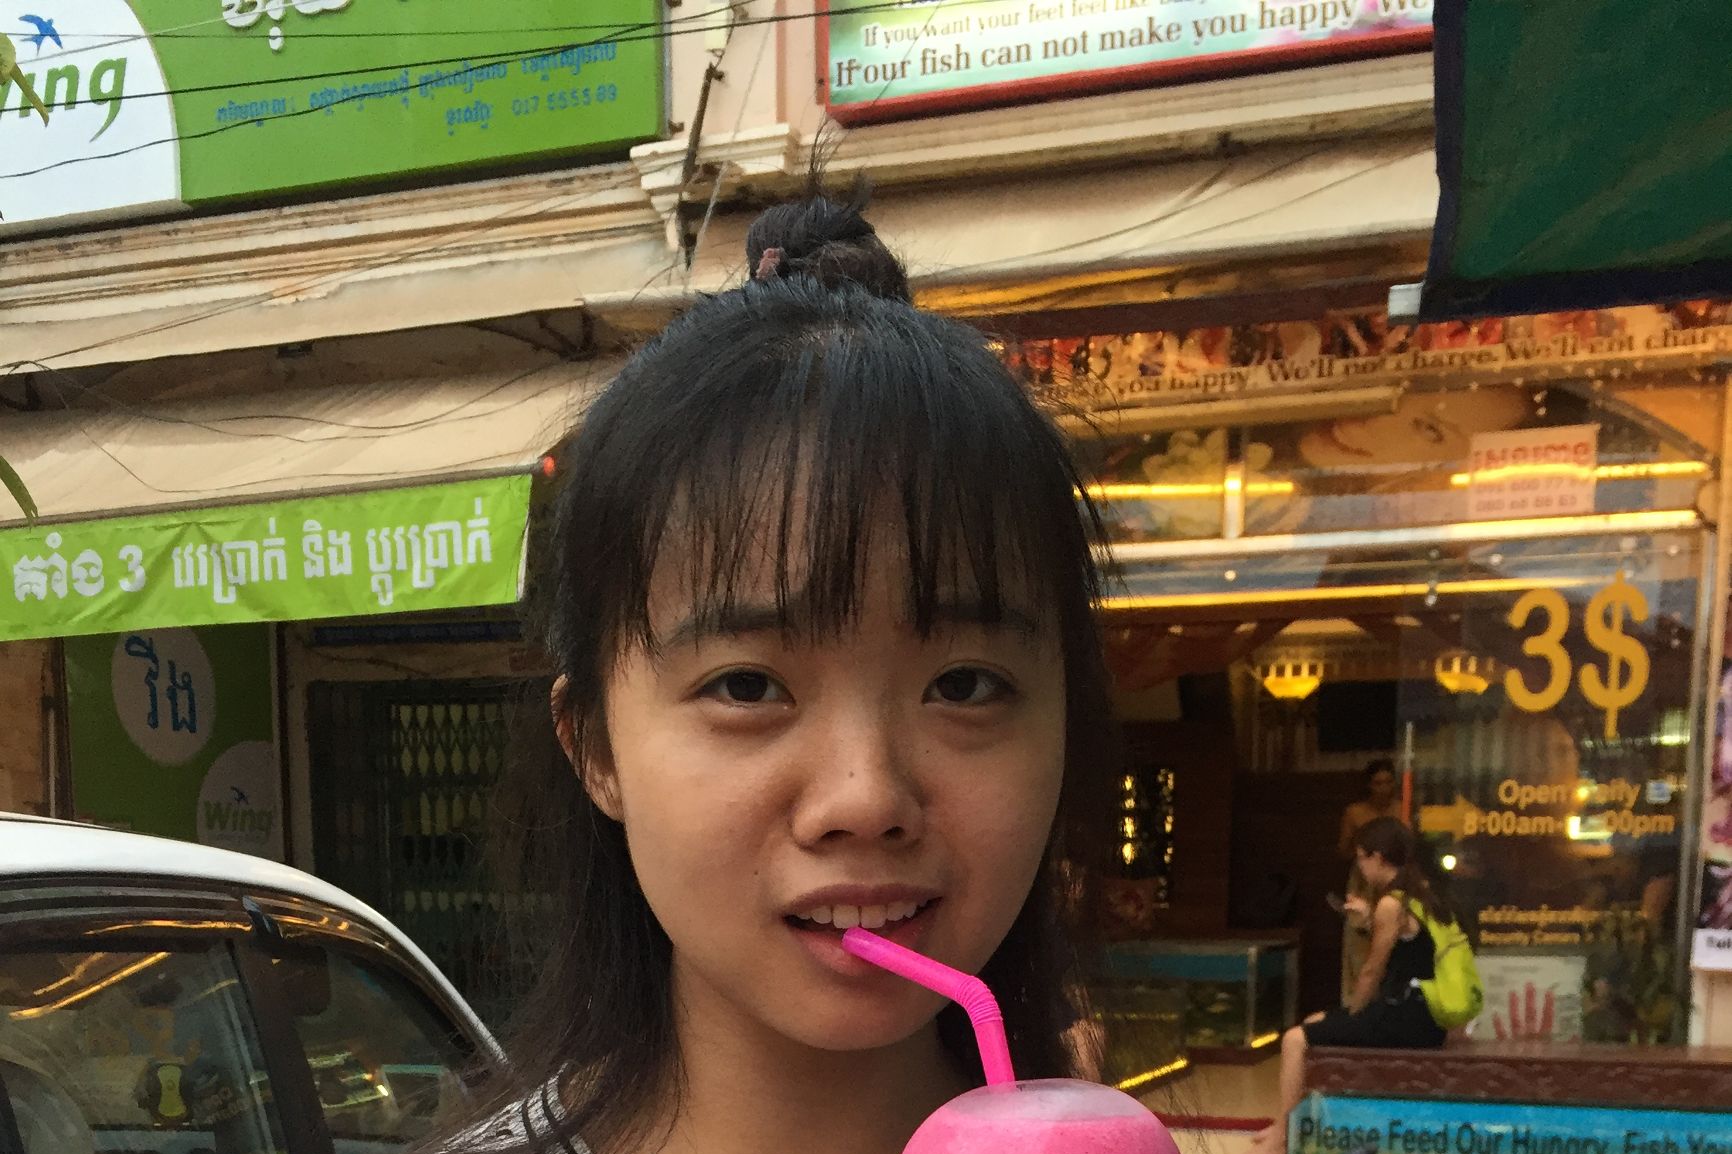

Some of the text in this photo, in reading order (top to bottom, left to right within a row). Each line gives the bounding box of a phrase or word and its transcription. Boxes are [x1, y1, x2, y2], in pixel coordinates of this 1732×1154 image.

[864, 25, 878, 47] If
[884, 27, 917, 48] you
[924, 15, 971, 37] want
[977, 12, 1020, 36] your
[864, 59, 911, 84] our
[920, 43, 971, 76] fish
[981, 42, 1032, 68] can
[1042, 30, 1090, 60] not
[1100, 16, 1182, 53] make
[1192, 12, 1247, 46] you
[1257, 0, 1352, 31] happy
[0, 57, 127, 143] ing
[118, 544, 145, 592] 3
[1504, 570, 1650, 740] 3$
[1498, 778, 1564, 810] Open
[1300, 1117, 1381, 1151] Please
[1388, 1118, 1448, 1154] Feed
